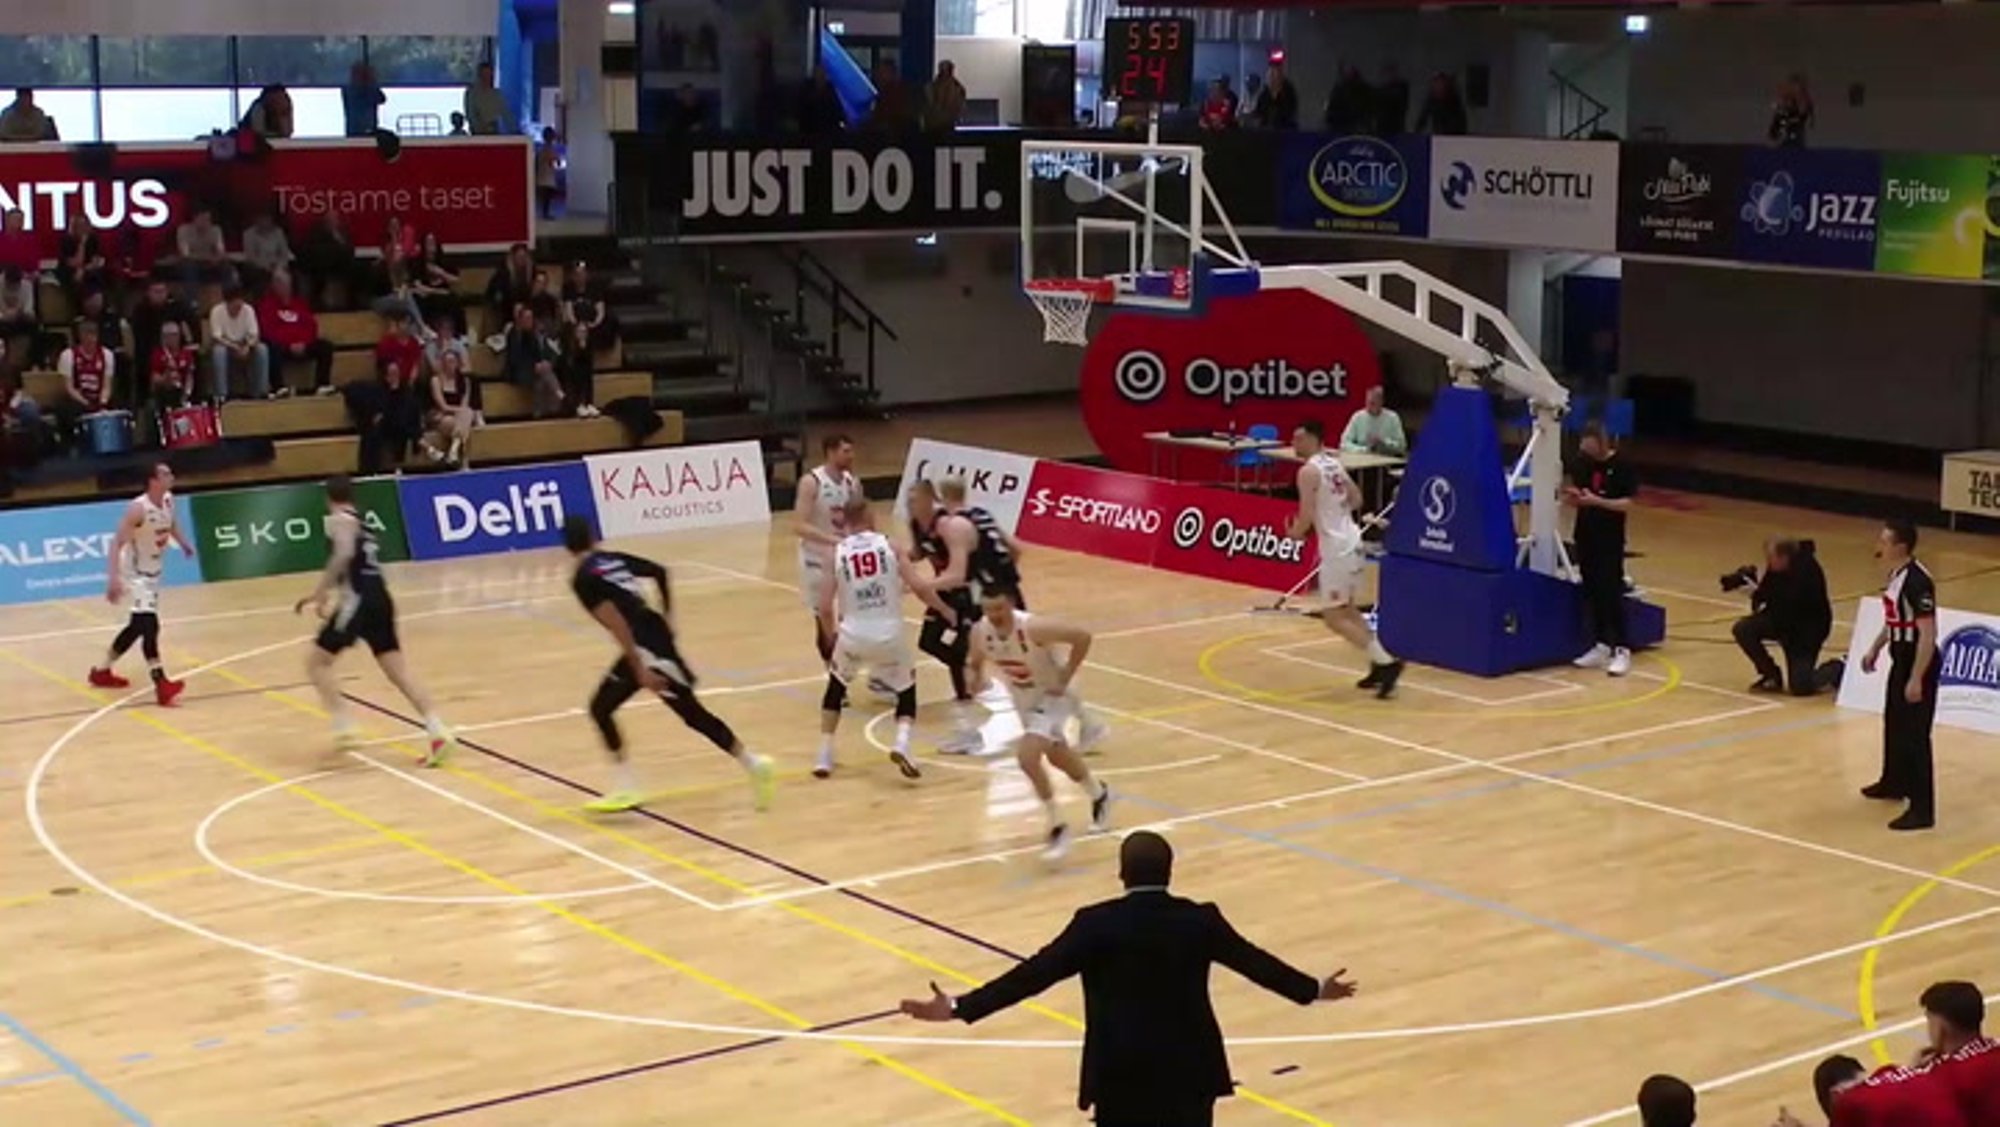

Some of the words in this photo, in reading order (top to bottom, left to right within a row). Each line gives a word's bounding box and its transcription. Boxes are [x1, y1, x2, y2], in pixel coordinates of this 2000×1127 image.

[1121, 54, 1167, 96] 24
[683, 148, 811, 218] JUST
[832, 147, 913, 213] DO
[935, 146, 1002, 211] IT.
[1321, 160, 1398, 187] ARCTIC
[1484, 166, 1592, 199] SCHÖTTLI
[1887, 180, 1950, 208] Fujitsu
[420, 184, 495, 209] taset
[1185, 358, 1347, 404] Optibet
[601, 456, 751, 502] KAJAJA
[214, 508, 387, 549] SKOA
[433, 480, 565, 543] Delfi
[642, 500, 725, 520] ACOUSTICS
[1055, 493, 1160, 534] SPORTLAND
[1210, 517, 1305, 562] Optibet
[849, 551, 879, 578] 19
[1941, 642, 1998, 684] AURA
